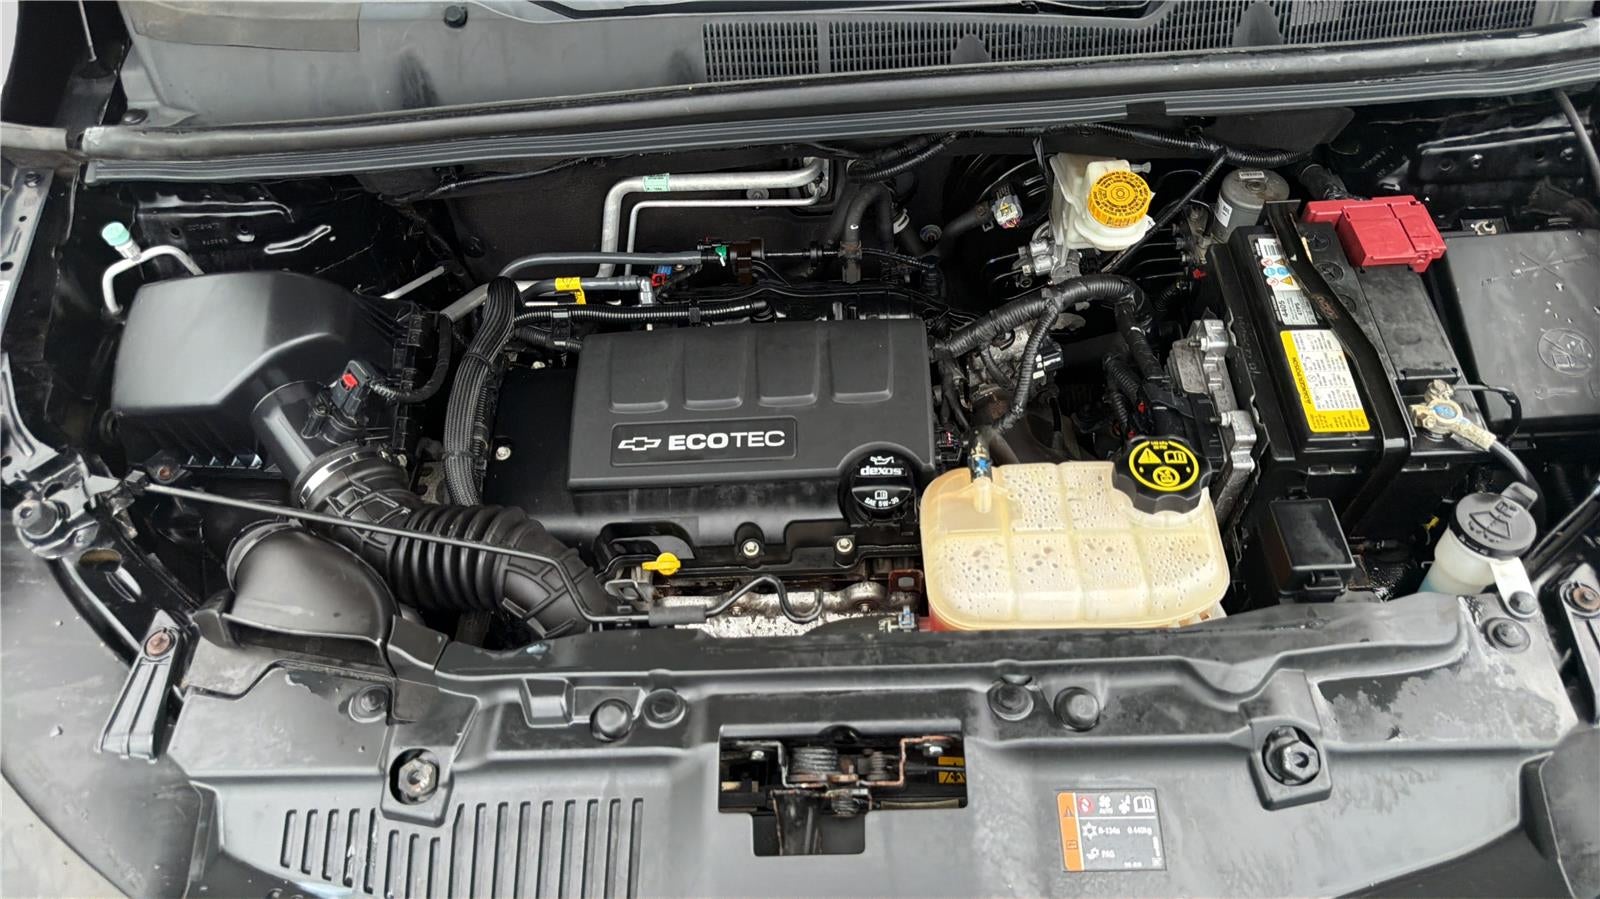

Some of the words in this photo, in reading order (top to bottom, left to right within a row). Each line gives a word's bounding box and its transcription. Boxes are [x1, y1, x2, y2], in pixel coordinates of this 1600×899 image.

[668, 430, 786, 451] ECOTEC
[860, 465, 902, 476] dexos
[864, 496, 877, 507] SAE
